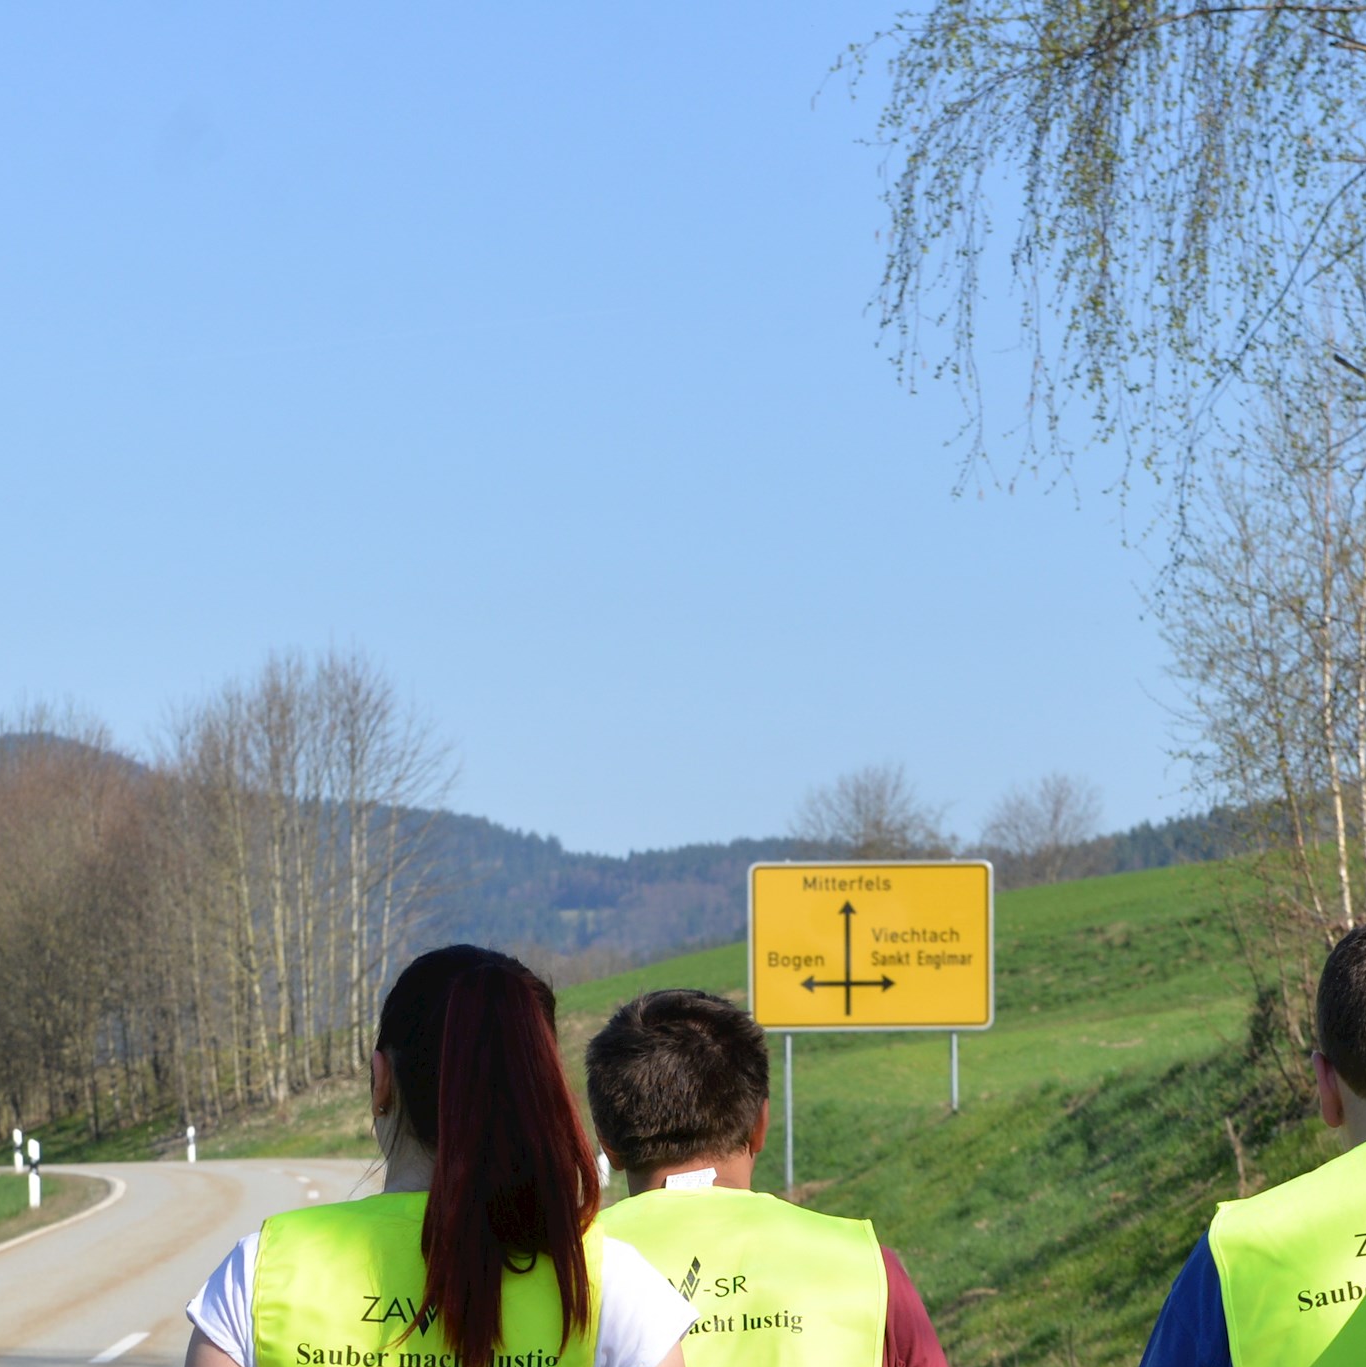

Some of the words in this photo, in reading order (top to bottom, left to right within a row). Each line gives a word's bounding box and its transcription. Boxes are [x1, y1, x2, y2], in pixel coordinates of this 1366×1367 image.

[802, 875, 892, 892] Mitterfels
[871, 927, 960, 944] Viechtach
[767, 951, 825, 971] Bogen
[871, 951, 910, 967] Sankt
[688, 1314, 735, 1335] acht
[742, 1309, 803, 1334] lustig
[296, 1342, 389, 1367] Sauber
